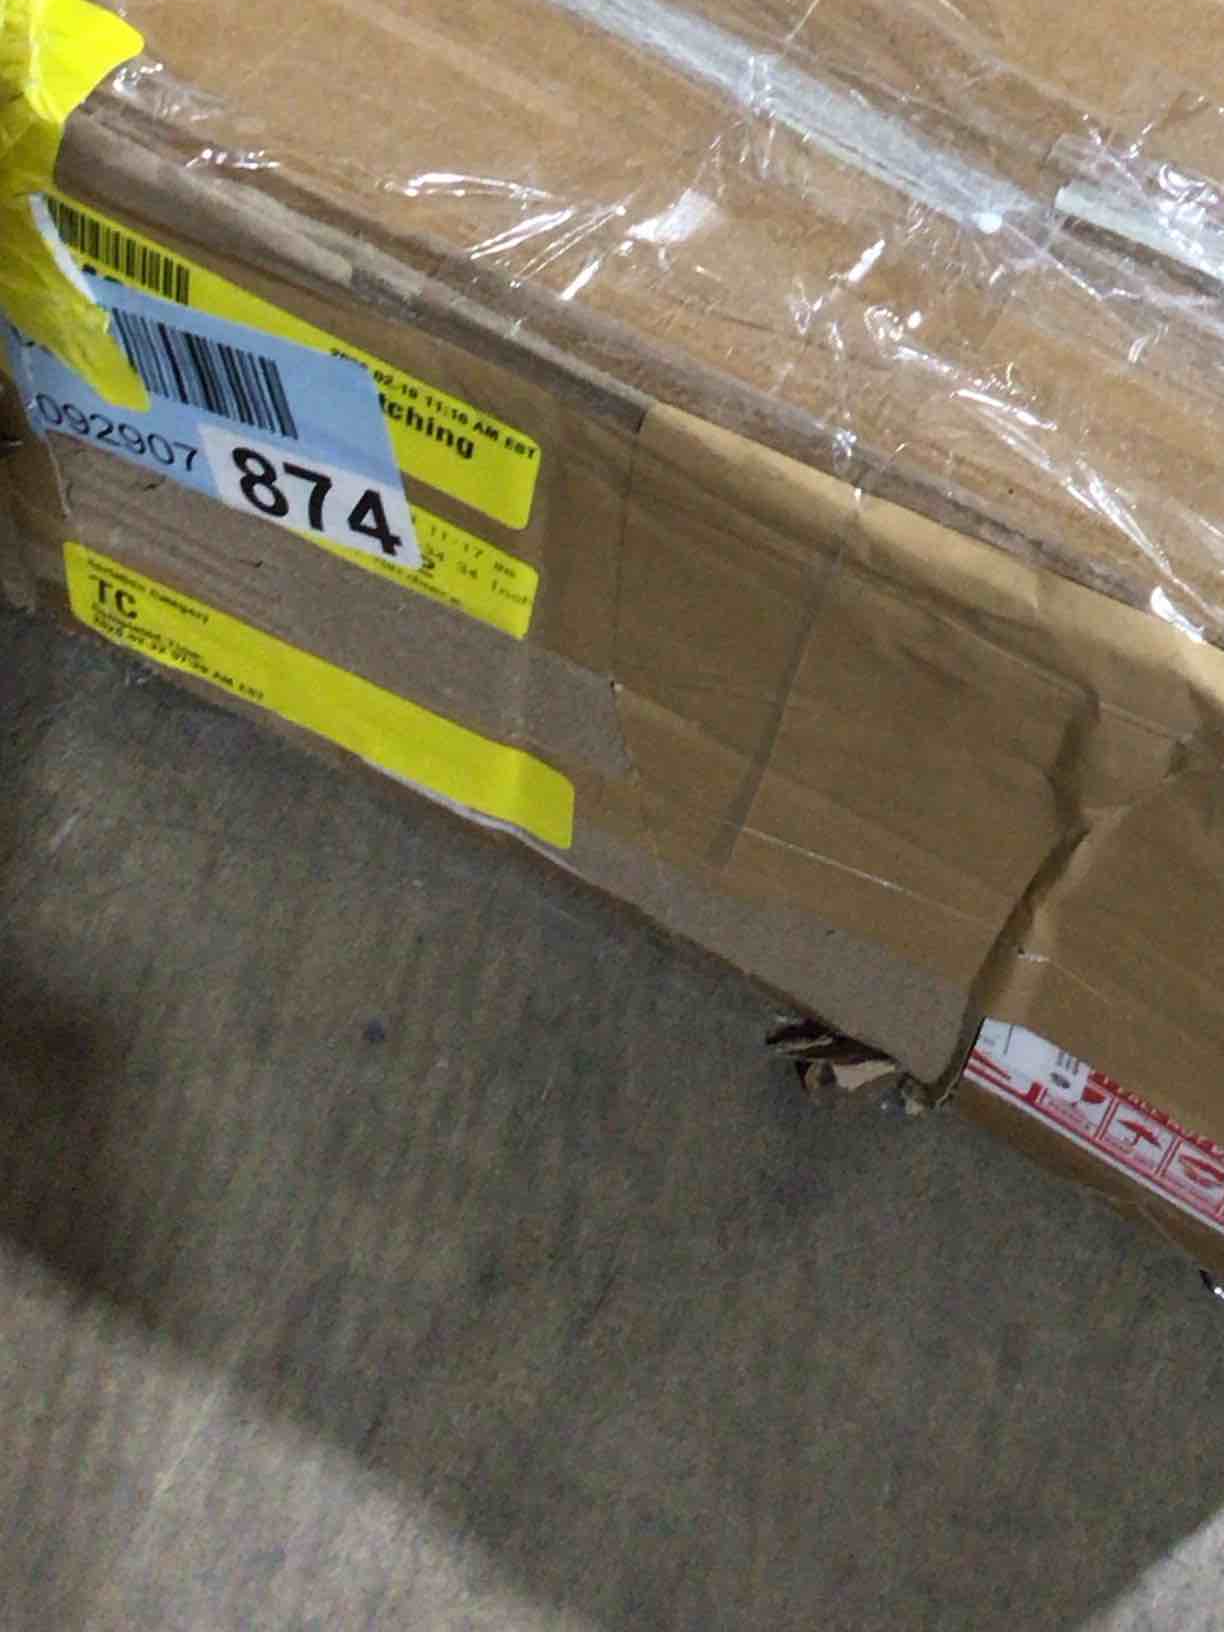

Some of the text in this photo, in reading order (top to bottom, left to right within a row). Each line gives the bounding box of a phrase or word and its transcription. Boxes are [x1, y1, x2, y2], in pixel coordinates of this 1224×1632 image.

[35, 392, 403, 557] 092907 874
[88, 573, 138, 620] TC
